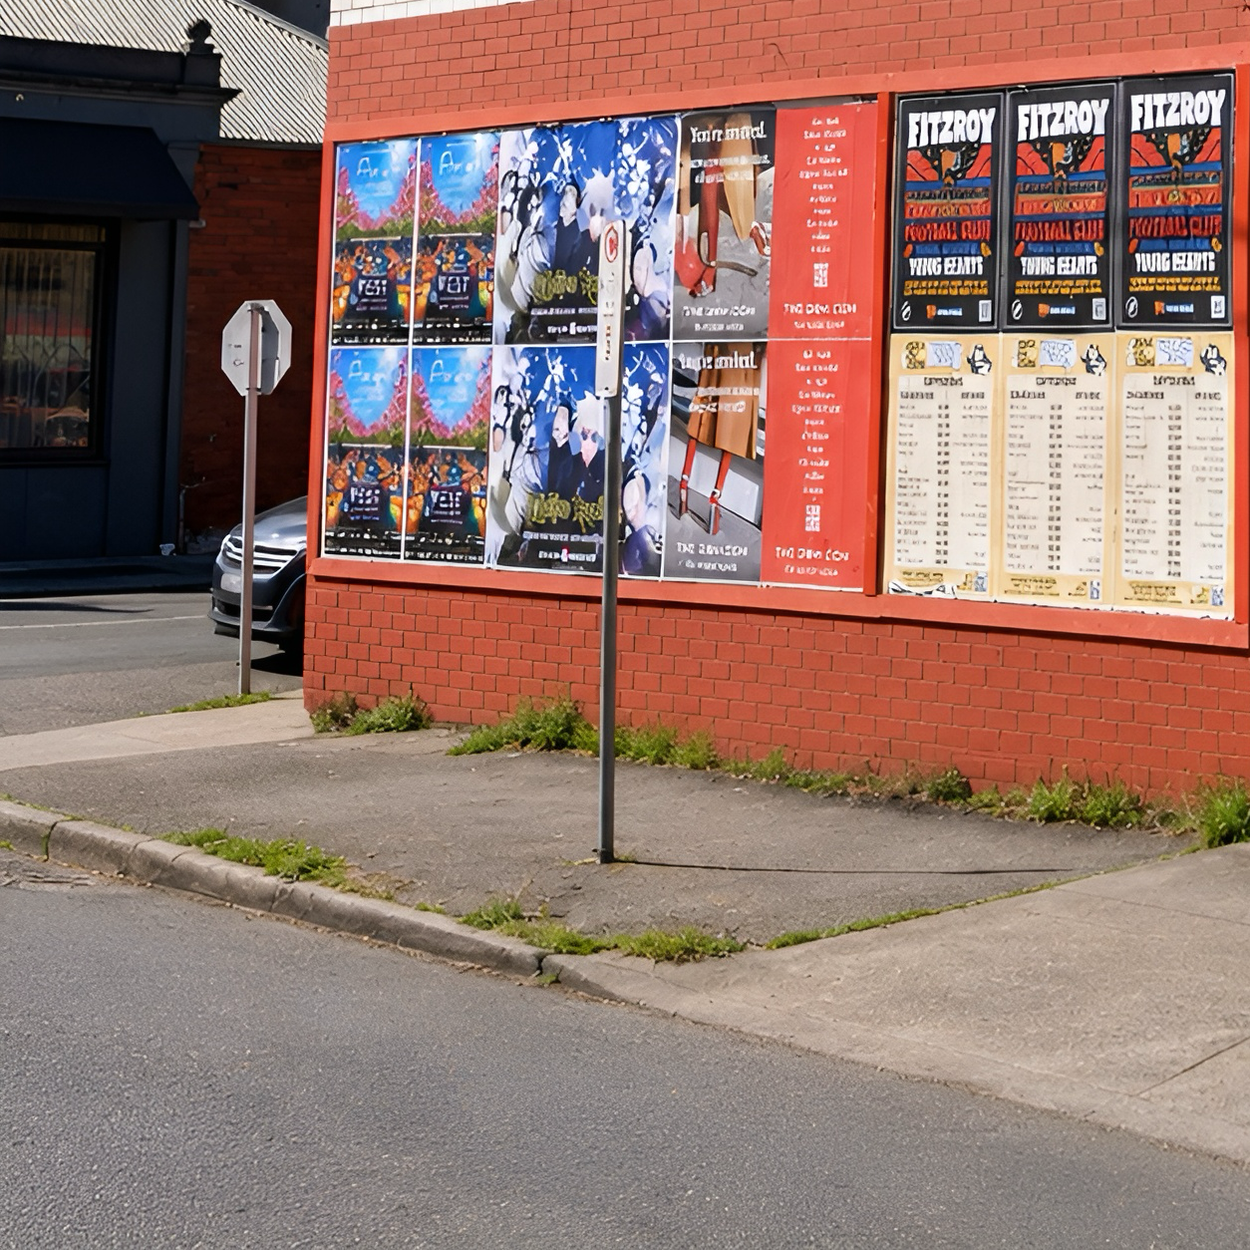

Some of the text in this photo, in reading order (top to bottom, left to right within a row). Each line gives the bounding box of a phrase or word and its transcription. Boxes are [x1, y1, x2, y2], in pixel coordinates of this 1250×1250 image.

[907, 107, 996, 149] FITZROY
[1017, 99, 1110, 142] FITZROY
[1130, 89, 1227, 132] FITZROY
